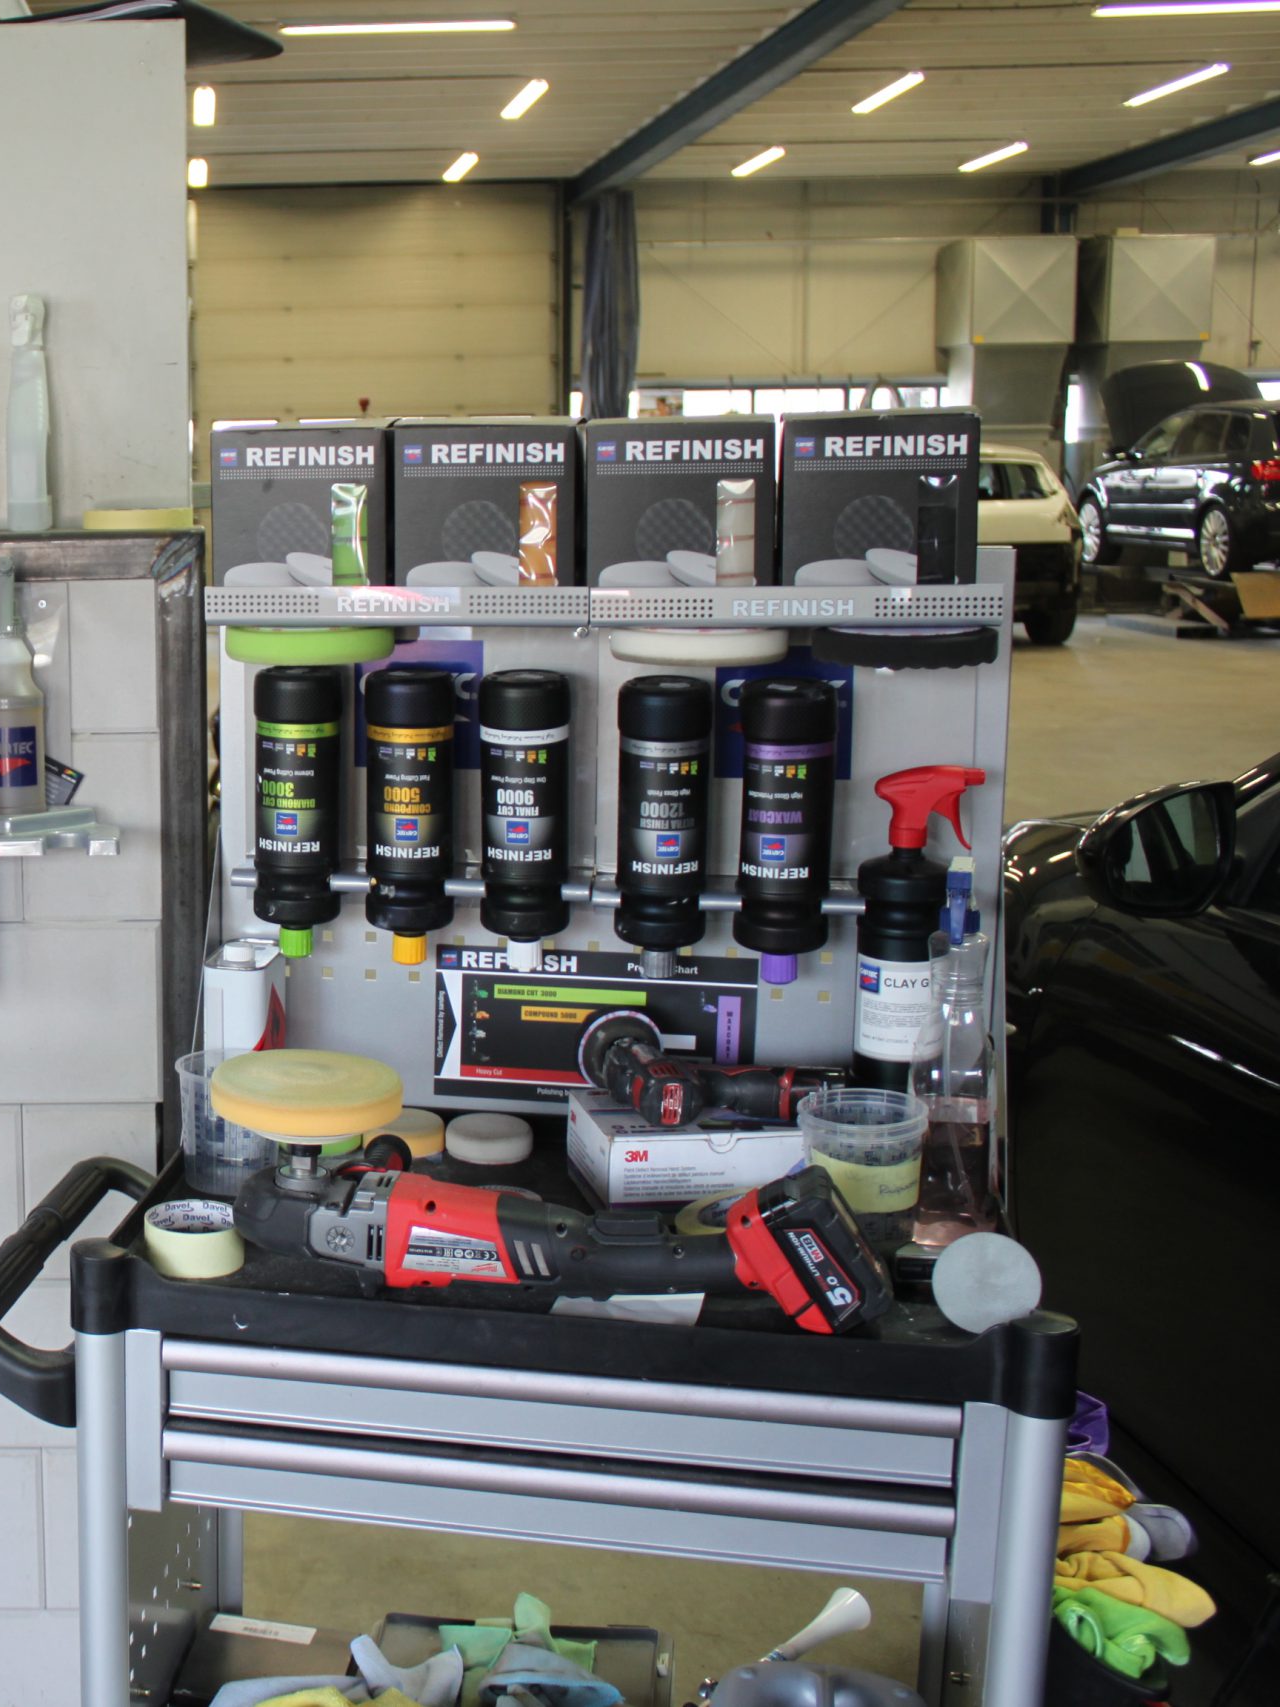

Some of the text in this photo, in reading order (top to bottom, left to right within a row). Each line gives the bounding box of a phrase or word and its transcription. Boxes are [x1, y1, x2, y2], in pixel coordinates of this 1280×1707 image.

[431, 443, 566, 465] REFINISH
[625, 438, 765, 462] REFINISH
[824, 434, 969, 458] REFINISH
[246, 445, 375, 467] REFINISH
[337, 596, 450, 613] REFINISH
[732, 599, 854, 616] REFINISH
[262, 779, 295, 797] 3000
[383, 785, 421, 802] 5000
[262, 796, 316, 809] DIAMOND CUT
[496, 788, 535, 805] 9000
[383, 802, 432, 813] COMPOUND
[497, 805, 539, 816] FINAL CUT
[640, 801, 685, 819] 12000
[639, 818, 695, 830] ULTRA FINISH
[748, 808, 803, 825] WAXCOAT
[259, 837, 321, 853] REFINISH
[375, 843, 440, 859] REFINISH
[487, 846, 553, 862] REFINISH
[632, 860, 699, 876] REFINISH
[741, 862, 809, 879] REFINISH
[883, 977, 917, 989] CLAY
[497, 987, 558, 998] DIAMOND CUT 3000
[524, 1009, 577, 1020] COMPOUND 5000
[476, 1068, 492, 1076] Heavy
[537, 1087, 564, 1097] Polishing
[624, 1150, 649, 1163] 3M
[164, 1202, 190, 1212] Davel
[202, 1202, 228, 1212] Davel
[182, 1213, 210, 1223] Davel
[826, 1276, 853, 1306] 5.0
